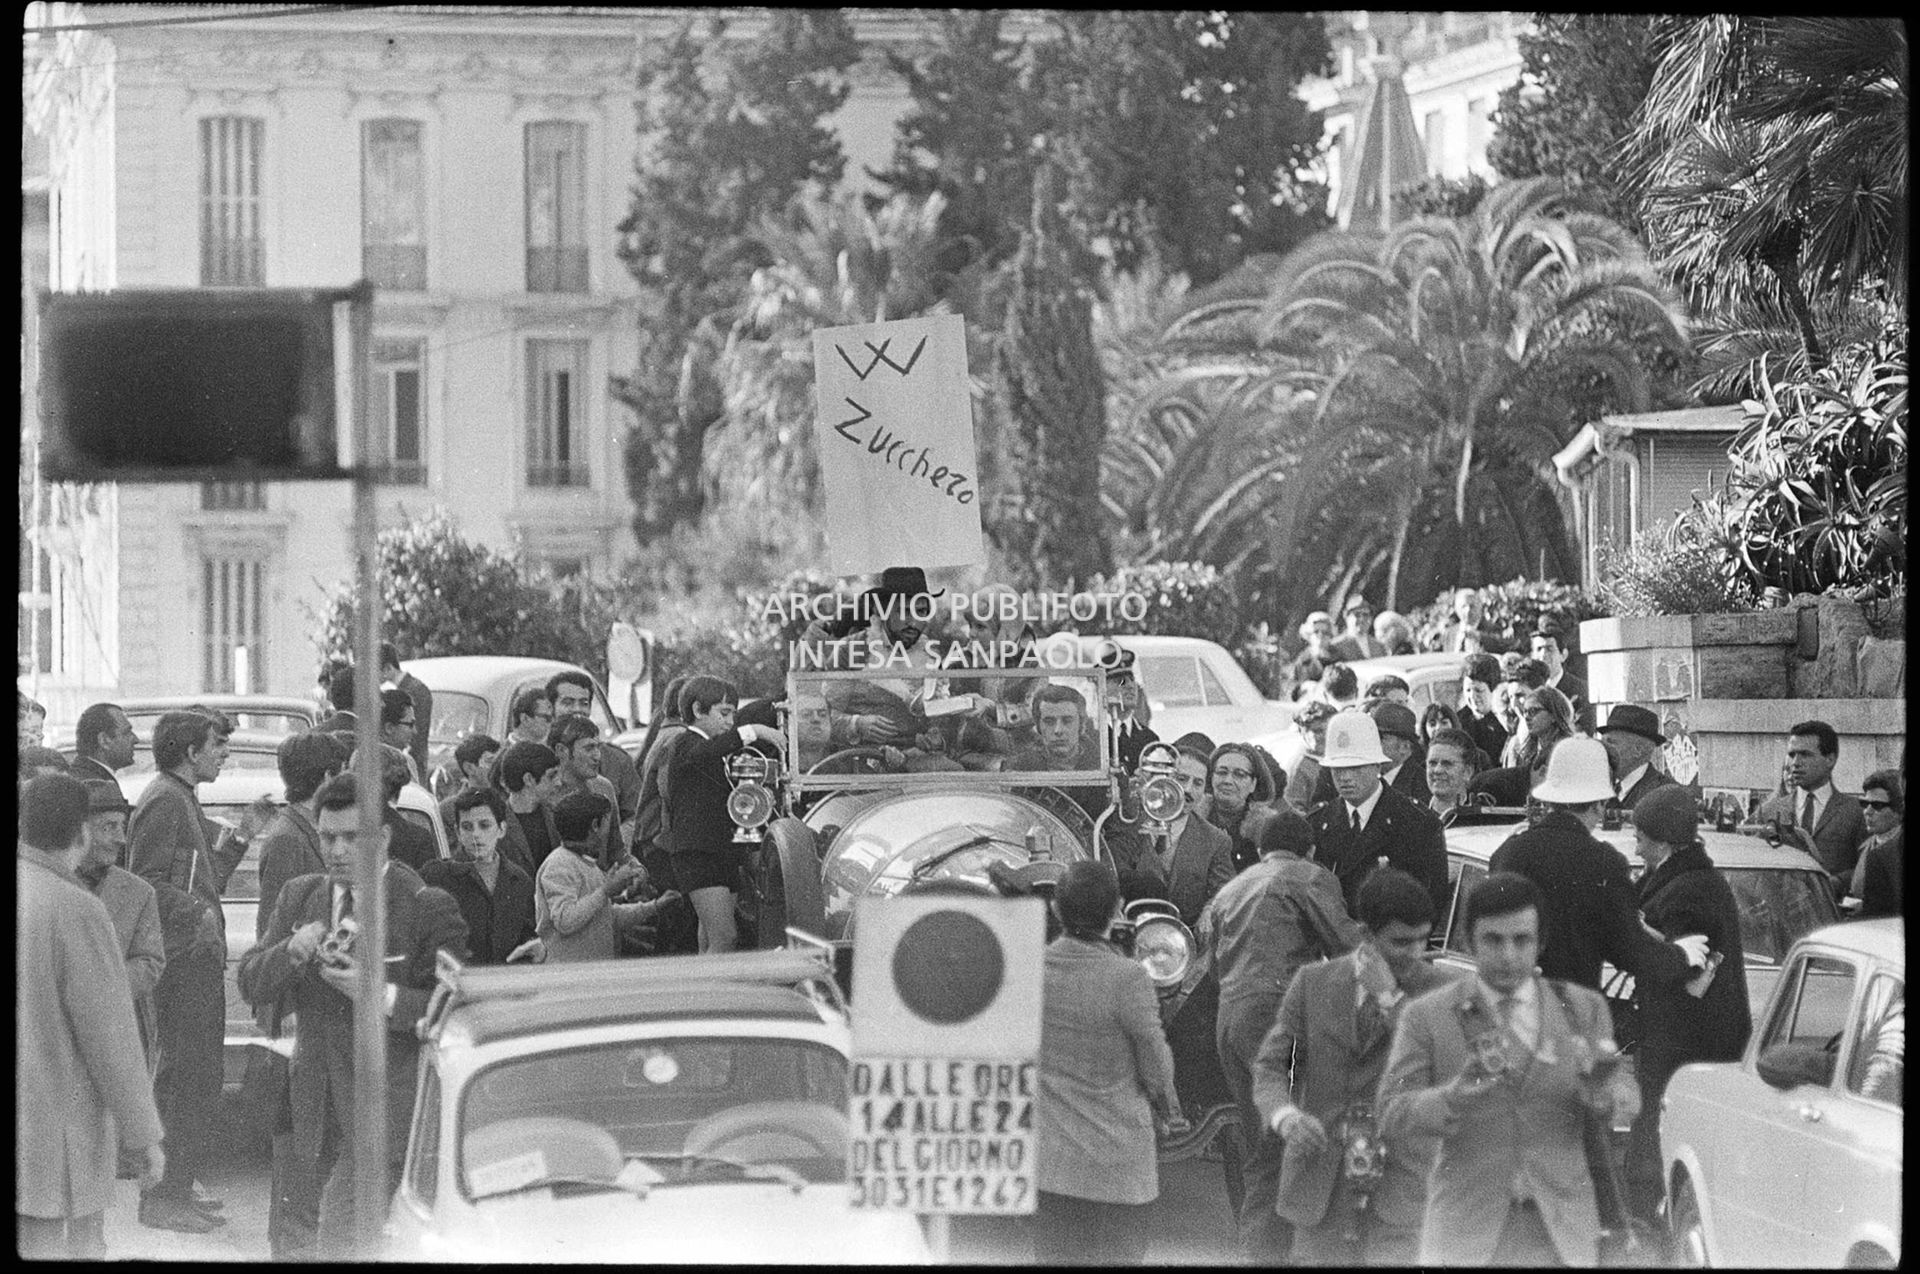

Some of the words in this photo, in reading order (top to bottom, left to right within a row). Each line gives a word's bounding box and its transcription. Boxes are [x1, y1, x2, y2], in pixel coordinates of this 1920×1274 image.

[853, 1063, 963, 1096] DALLE
[974, 1063, 1035, 1096] ORE
[853, 1138, 907, 1173] DEL
[914, 1138, 1024, 1172] GIORNO
